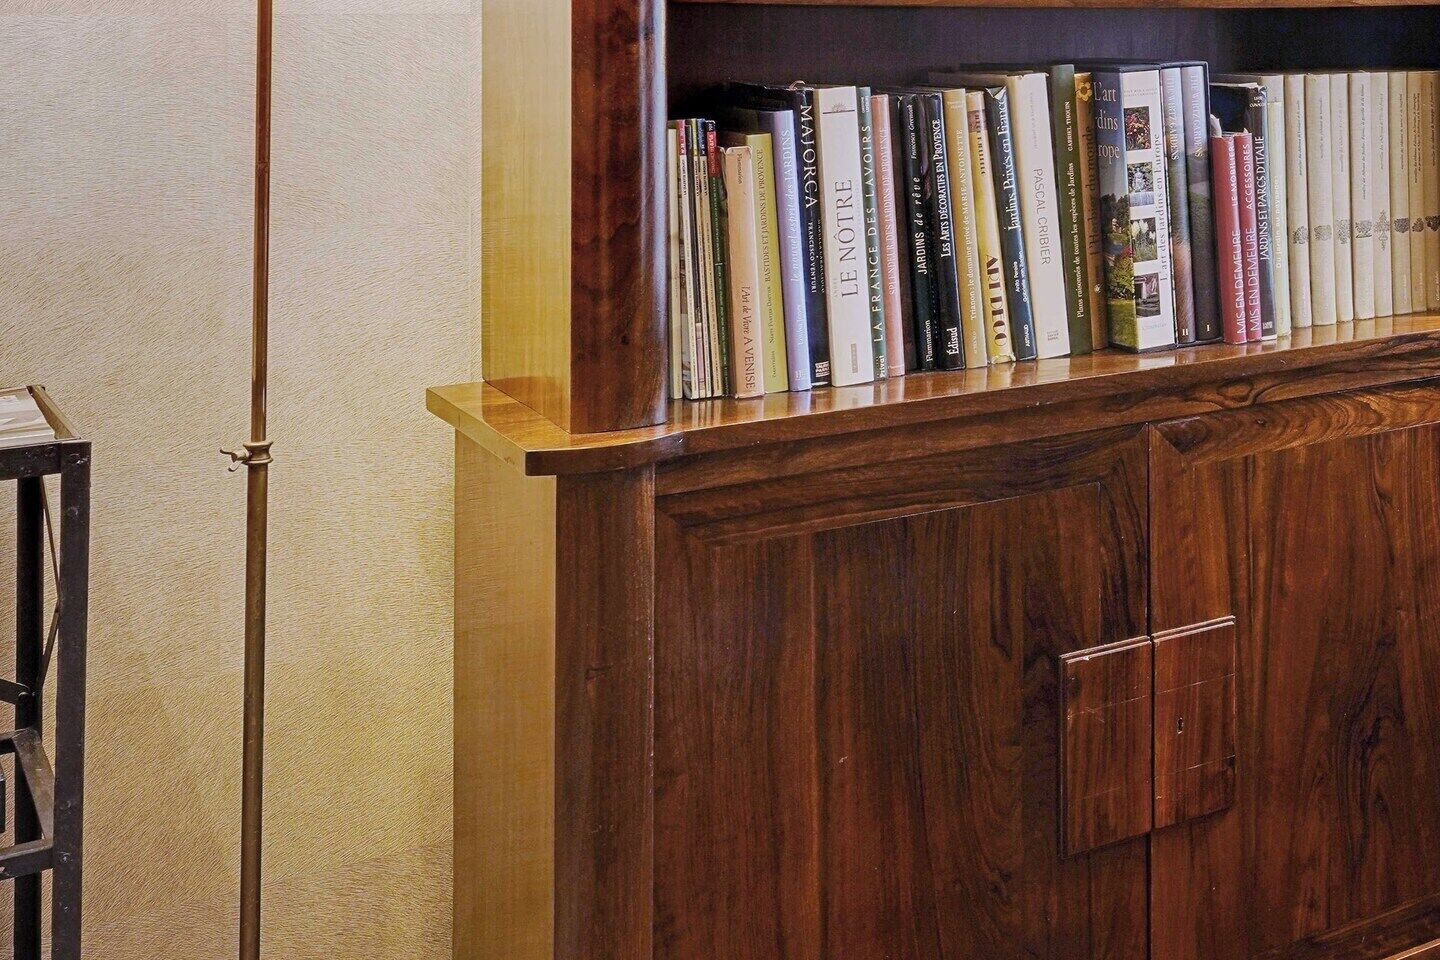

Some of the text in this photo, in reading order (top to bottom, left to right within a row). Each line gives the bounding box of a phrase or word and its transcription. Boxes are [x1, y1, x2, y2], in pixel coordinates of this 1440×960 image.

[1064, 102, 1072, 124] THOUIN
[1066, 126, 1074, 151] GABRIEL
[1032, 168, 1047, 214] PASCAL
[1067, 163, 1076, 186] Jardins
[1069, 188, 1077, 196] de
[1228, 146, 1239, 206] LE MOBILIER
[1242, 143, 1253, 209] ACCESSOIRES
[756, 149, 772, 282] BASTIDES ET JARDINS DE PROVENCE
[798, 105, 819, 293] MAJORCA FRANCESCO VENTURI
[1253, 136, 1270, 260] JARDINS ET PARCS D'ITALIE
[830, 179, 859, 298] LE NÔTRE
[861, 125, 884, 341] LA FRANCE DES LAVOIRS
[910, 176, 928, 275] JARDINS de rêve
[962, 216, 970, 224] de
[962, 226, 973, 241] privé
[1071, 224, 1079, 233] les
[964, 243, 974, 278] domaine
[1037, 217, 1052, 265] CRIBIER
[1072, 235, 1081, 257] toutes
[1231, 230, 1246, 334] MIS EN DEMEURE
[1245, 227, 1260, 331] MIS EN DEMEURE
[968, 291, 977, 320] Trianon
[985, 255, 1008, 346] ART DECO
[1075, 298, 1085, 317] Plans
[923, 320, 934, 361] Flammarion
[945, 327, 959, 355] Édisud
[877, 355, 886, 378] Privat
